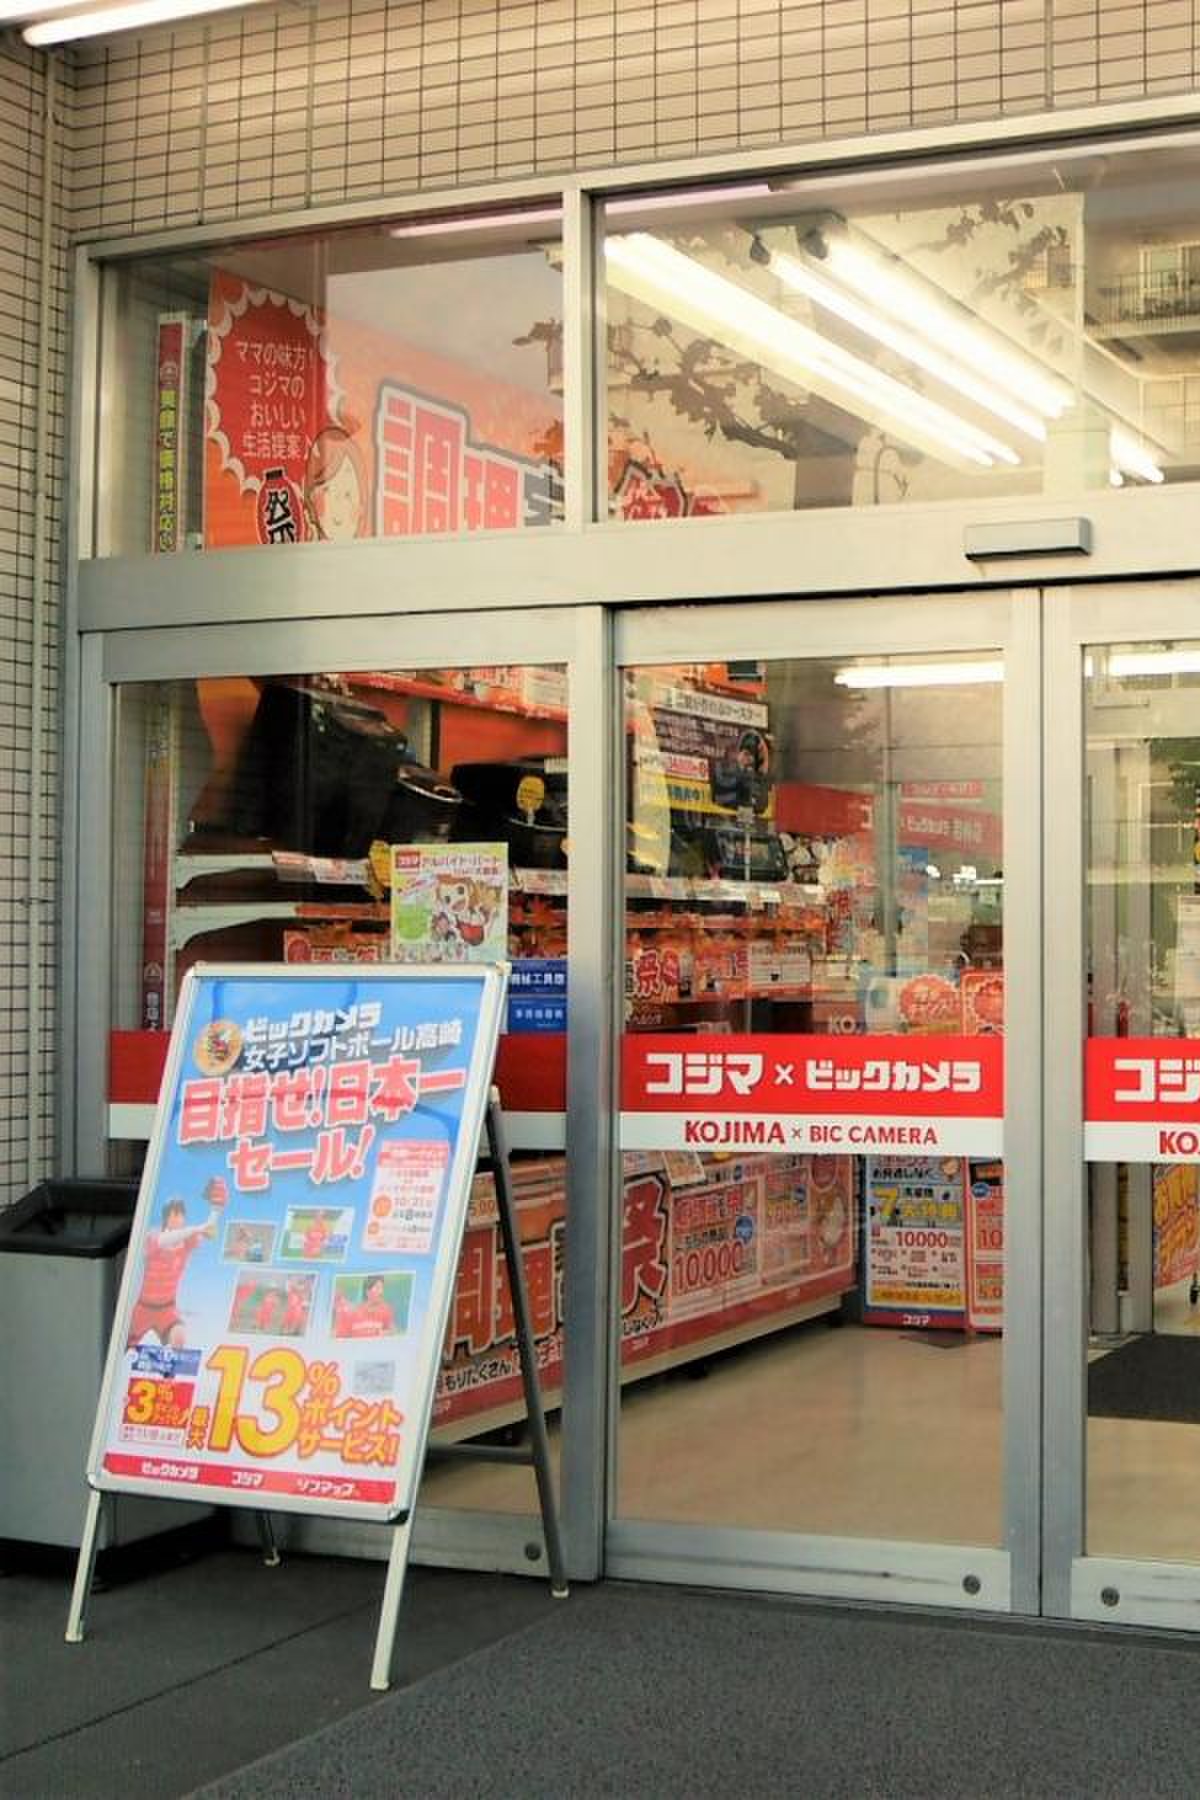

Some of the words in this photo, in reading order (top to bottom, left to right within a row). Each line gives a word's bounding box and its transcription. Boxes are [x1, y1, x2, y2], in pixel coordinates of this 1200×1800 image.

[249, 377, 304, 396] コジマの
[250, 404, 305, 427] おいしい
[244, 1002, 382, 1041] ビックカメラ
[243, 1020, 462, 1071] 女子ソフトボール高崎
[646, 1053, 763, 1094] コジマ
[806, 1060, 981, 1092] ビックカメラ
[178, 1055, 466, 1145] 目指せ!日本一
[685, 1120, 785, 1144] KOJIMA
[810, 1124, 842, 1142] BIC
[848, 1126, 938, 1145] CAMERA
[228, 1125, 376, 1192] セール!
[304, 1397, 403, 1428] ポイント
[300, 1428, 399, 1466] サービス!
[141, 1462, 198, 1480] ビックカメラ
[231, 1471, 263, 1487] コジマ
